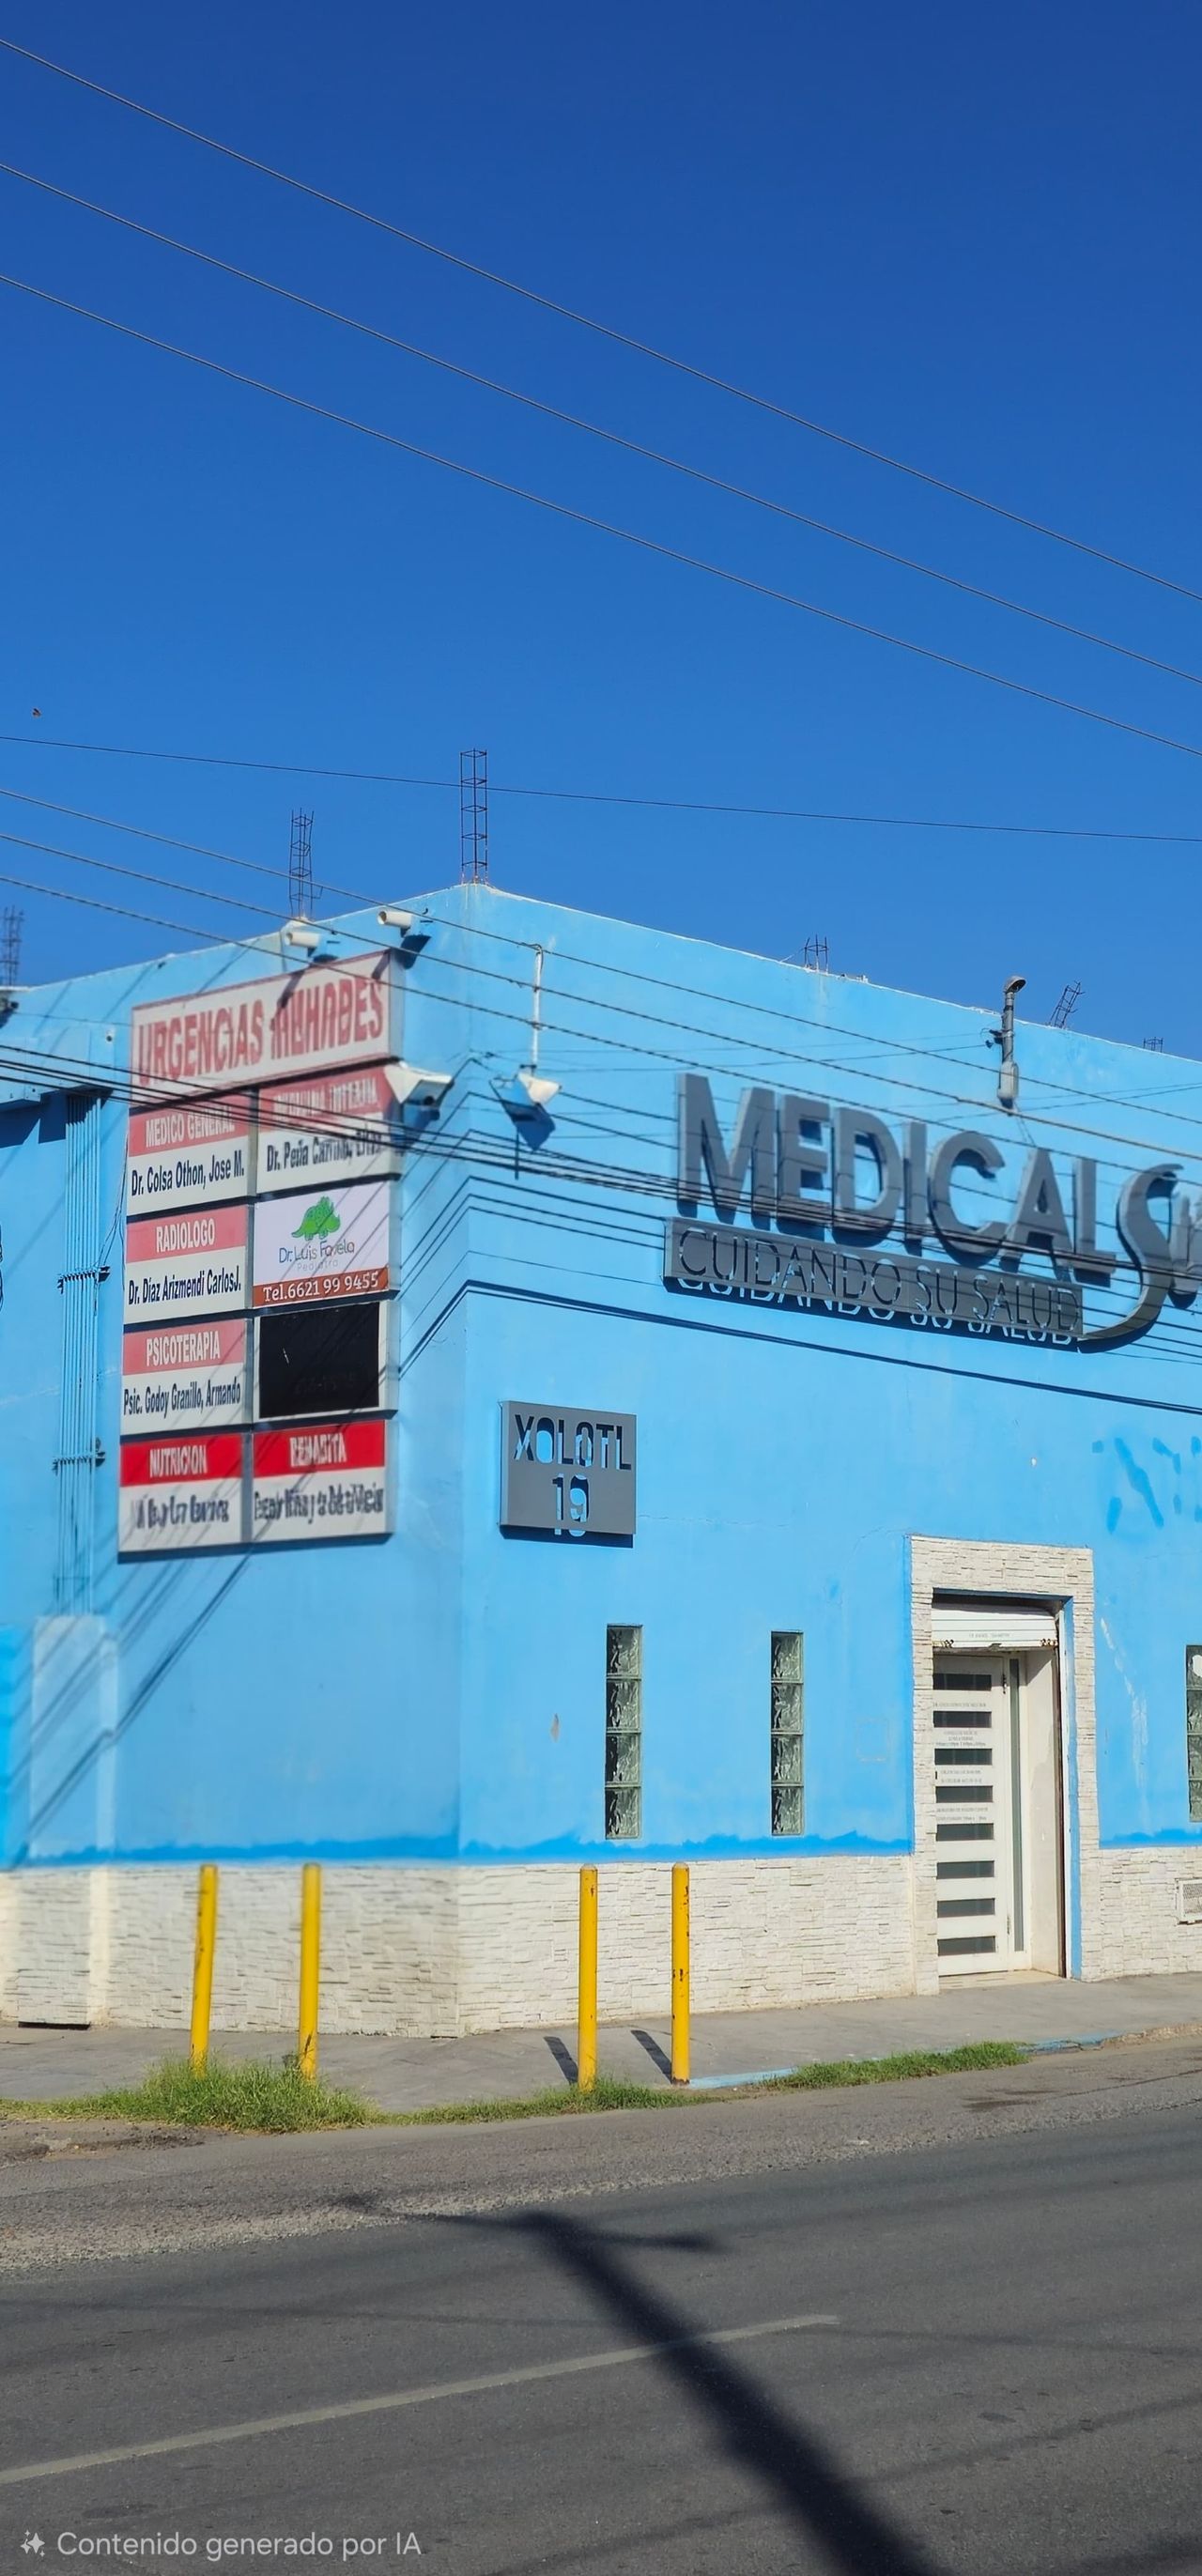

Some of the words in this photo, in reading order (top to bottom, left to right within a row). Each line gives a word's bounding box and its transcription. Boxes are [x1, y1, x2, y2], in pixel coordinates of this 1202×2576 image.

[139, 999, 264, 1087] URGENCIAS
[146, 1113, 185, 1148] MEDICO
[187, 1104, 236, 1139] GENERAL
[131, 1169, 144, 1196] Dr.
[146, 1166, 173, 1194] Colsa
[176, 1160, 206, 1190] Othon,
[208, 1154, 232, 1182] Jose
[233, 1149, 245, 1178] M.
[267, 1145, 281, 1173] Dr.
[676, 1072, 1117, 1275] MEDICAL
[156, 1218, 215, 1254] RADIOLOGO
[279, 1247, 293, 1263] Dr.
[294, 1245, 317, 1262] Luis
[129, 1279, 140, 1305] Dr.
[162, 1270, 206, 1302] Arizmendi
[323, 1277, 341, 1294] 99
[344, 1272, 379, 1290] 9455
[679, 1226, 902, 1306] CUIDANDO
[915, 1264, 958, 1315] SU
[972, 1273, 1079, 1332] SALUD
[146, 1331, 221, 1367] PSICOTERAPIA
[123, 1388, 143, 1416] Psic.
[145, 1384, 169, 1419] Godoy
[171, 1381, 204, 1413] Granillo,
[206, 1376, 241, 1407] Armando
[149, 1444, 208, 1478] NUTRICION
[514, 1413, 632, 1471] XOLOTL
[552, 1473, 590, 1522] 19
